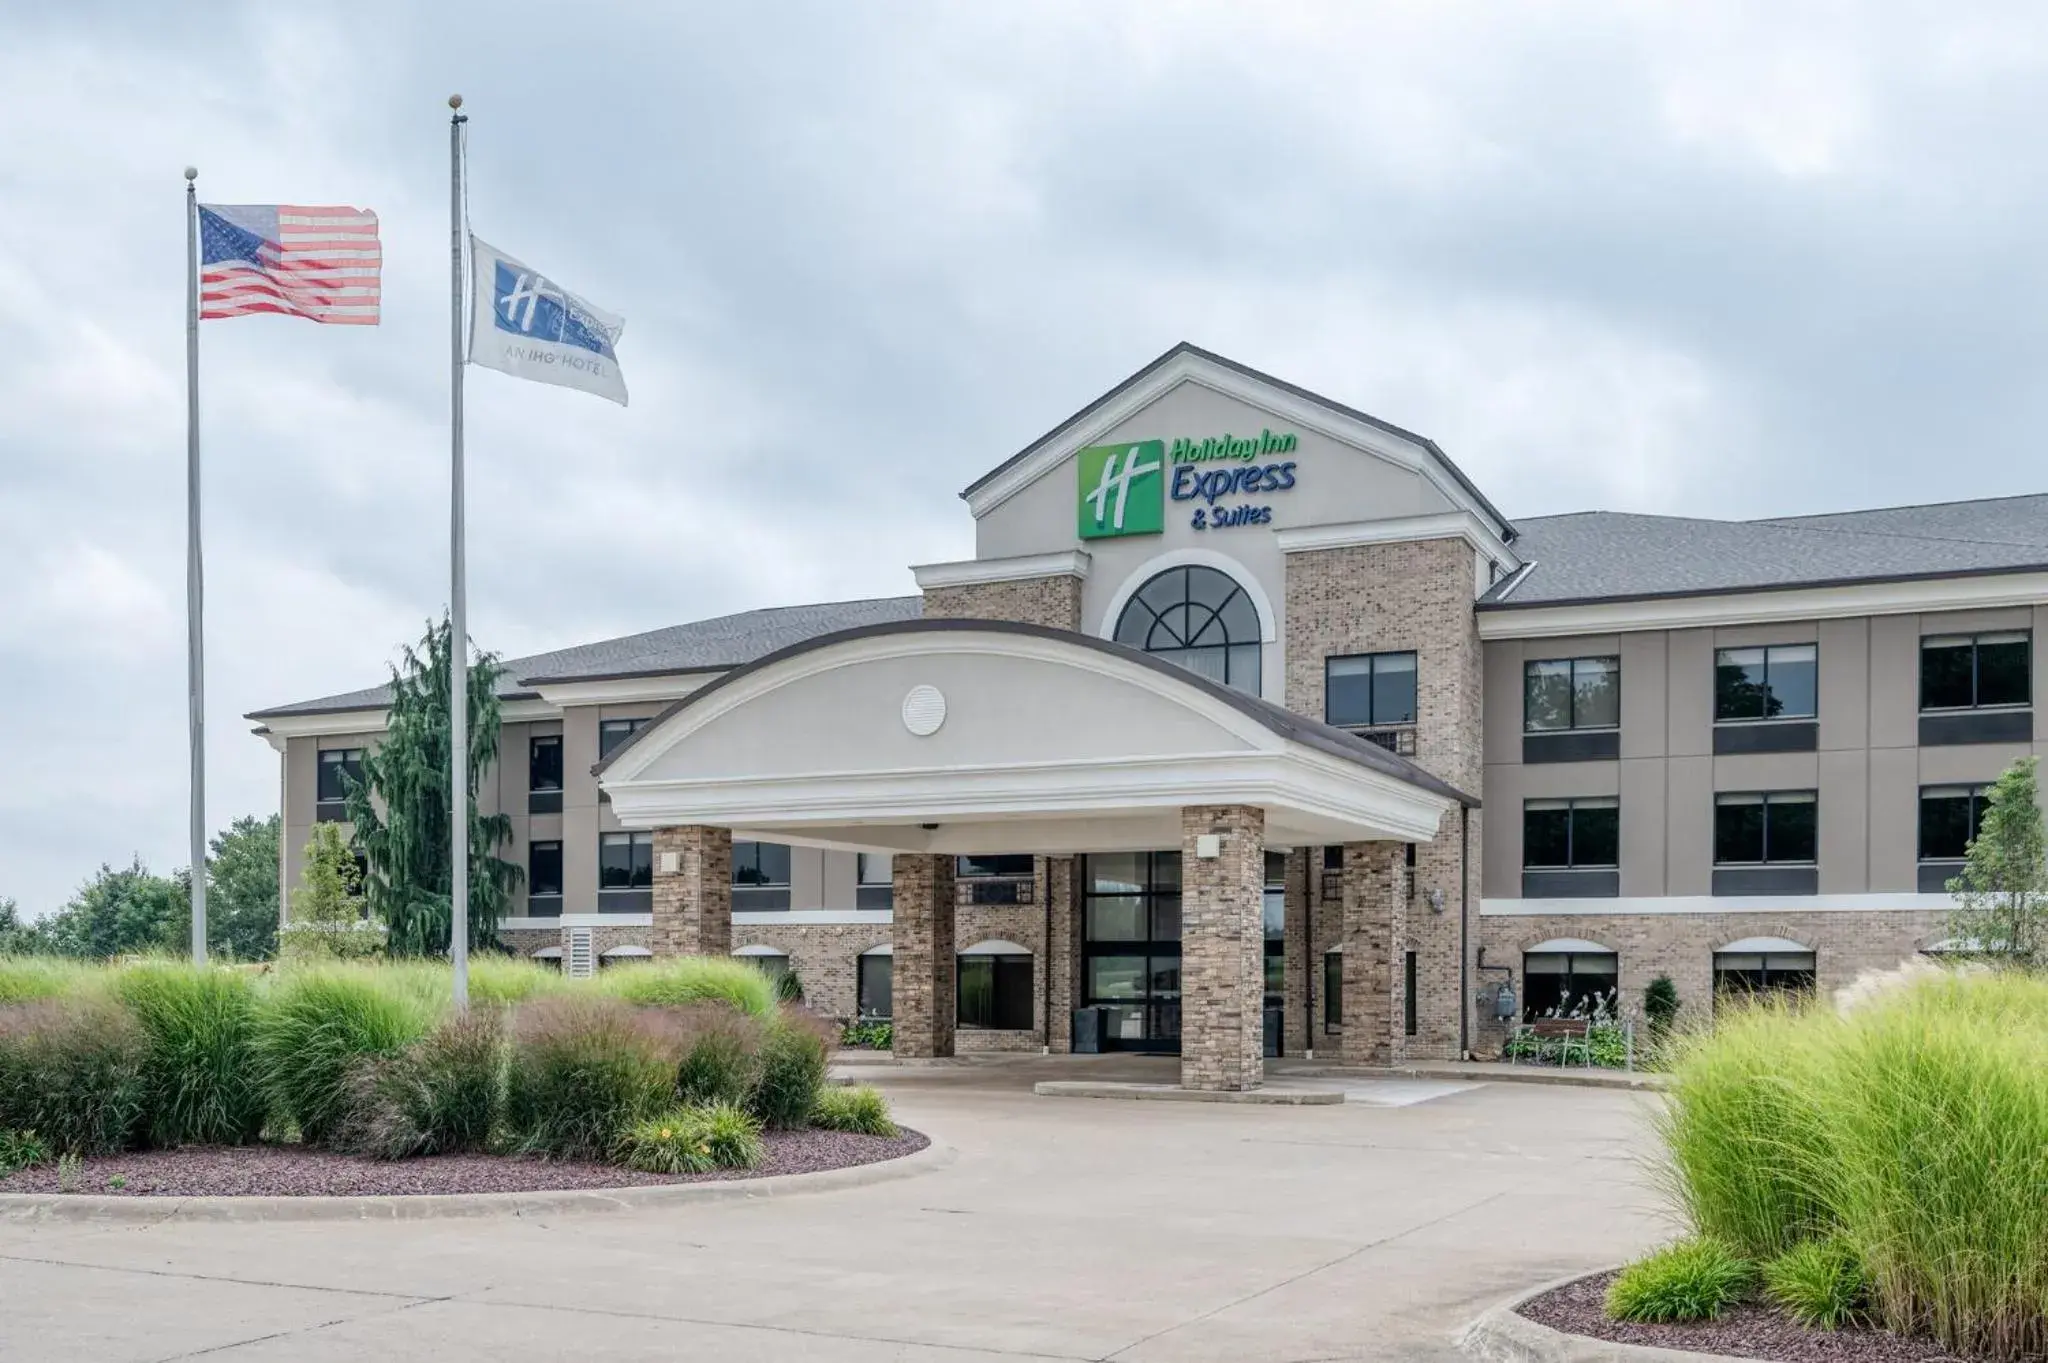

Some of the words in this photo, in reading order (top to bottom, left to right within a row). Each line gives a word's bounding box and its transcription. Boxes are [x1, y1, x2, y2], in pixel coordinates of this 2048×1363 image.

[504, 345, 525, 360] AN
[561, 353, 610, 378] HOTEL
[1170, 432, 1258, 464] Holiday
[1260, 428, 1297, 455] Inn
[1170, 461, 1297, 506] Express
[1190, 508, 1207, 530] &
[1210, 504, 1272, 528] Suites
